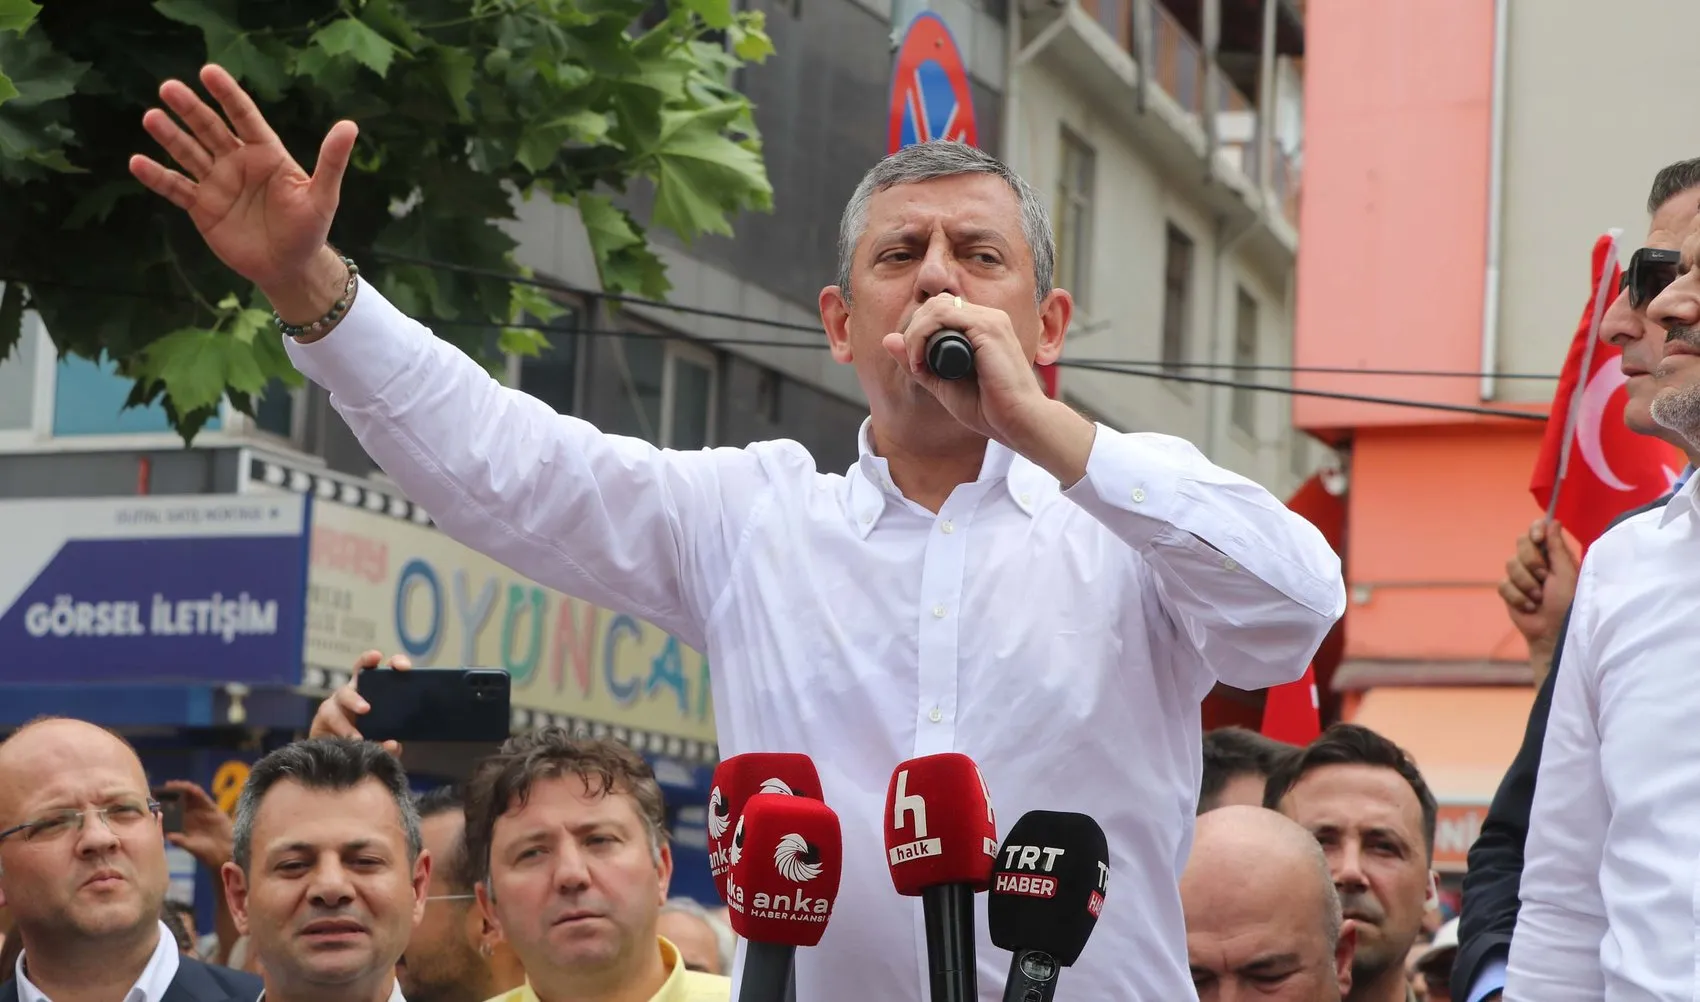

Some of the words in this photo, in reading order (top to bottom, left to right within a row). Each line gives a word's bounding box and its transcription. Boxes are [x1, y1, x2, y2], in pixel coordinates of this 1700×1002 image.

[25, 594, 145, 637] GÖRSEL
[151, 592, 279, 643] İLETİŞİM
[896, 842, 929, 860] halk
[1005, 845, 1065, 872] TRT
[996, 875, 1054, 896] HABER
[753, 888, 829, 914] anka
[751, 908, 789, 920] HABER
[789, 913, 826, 923] AJANSI
